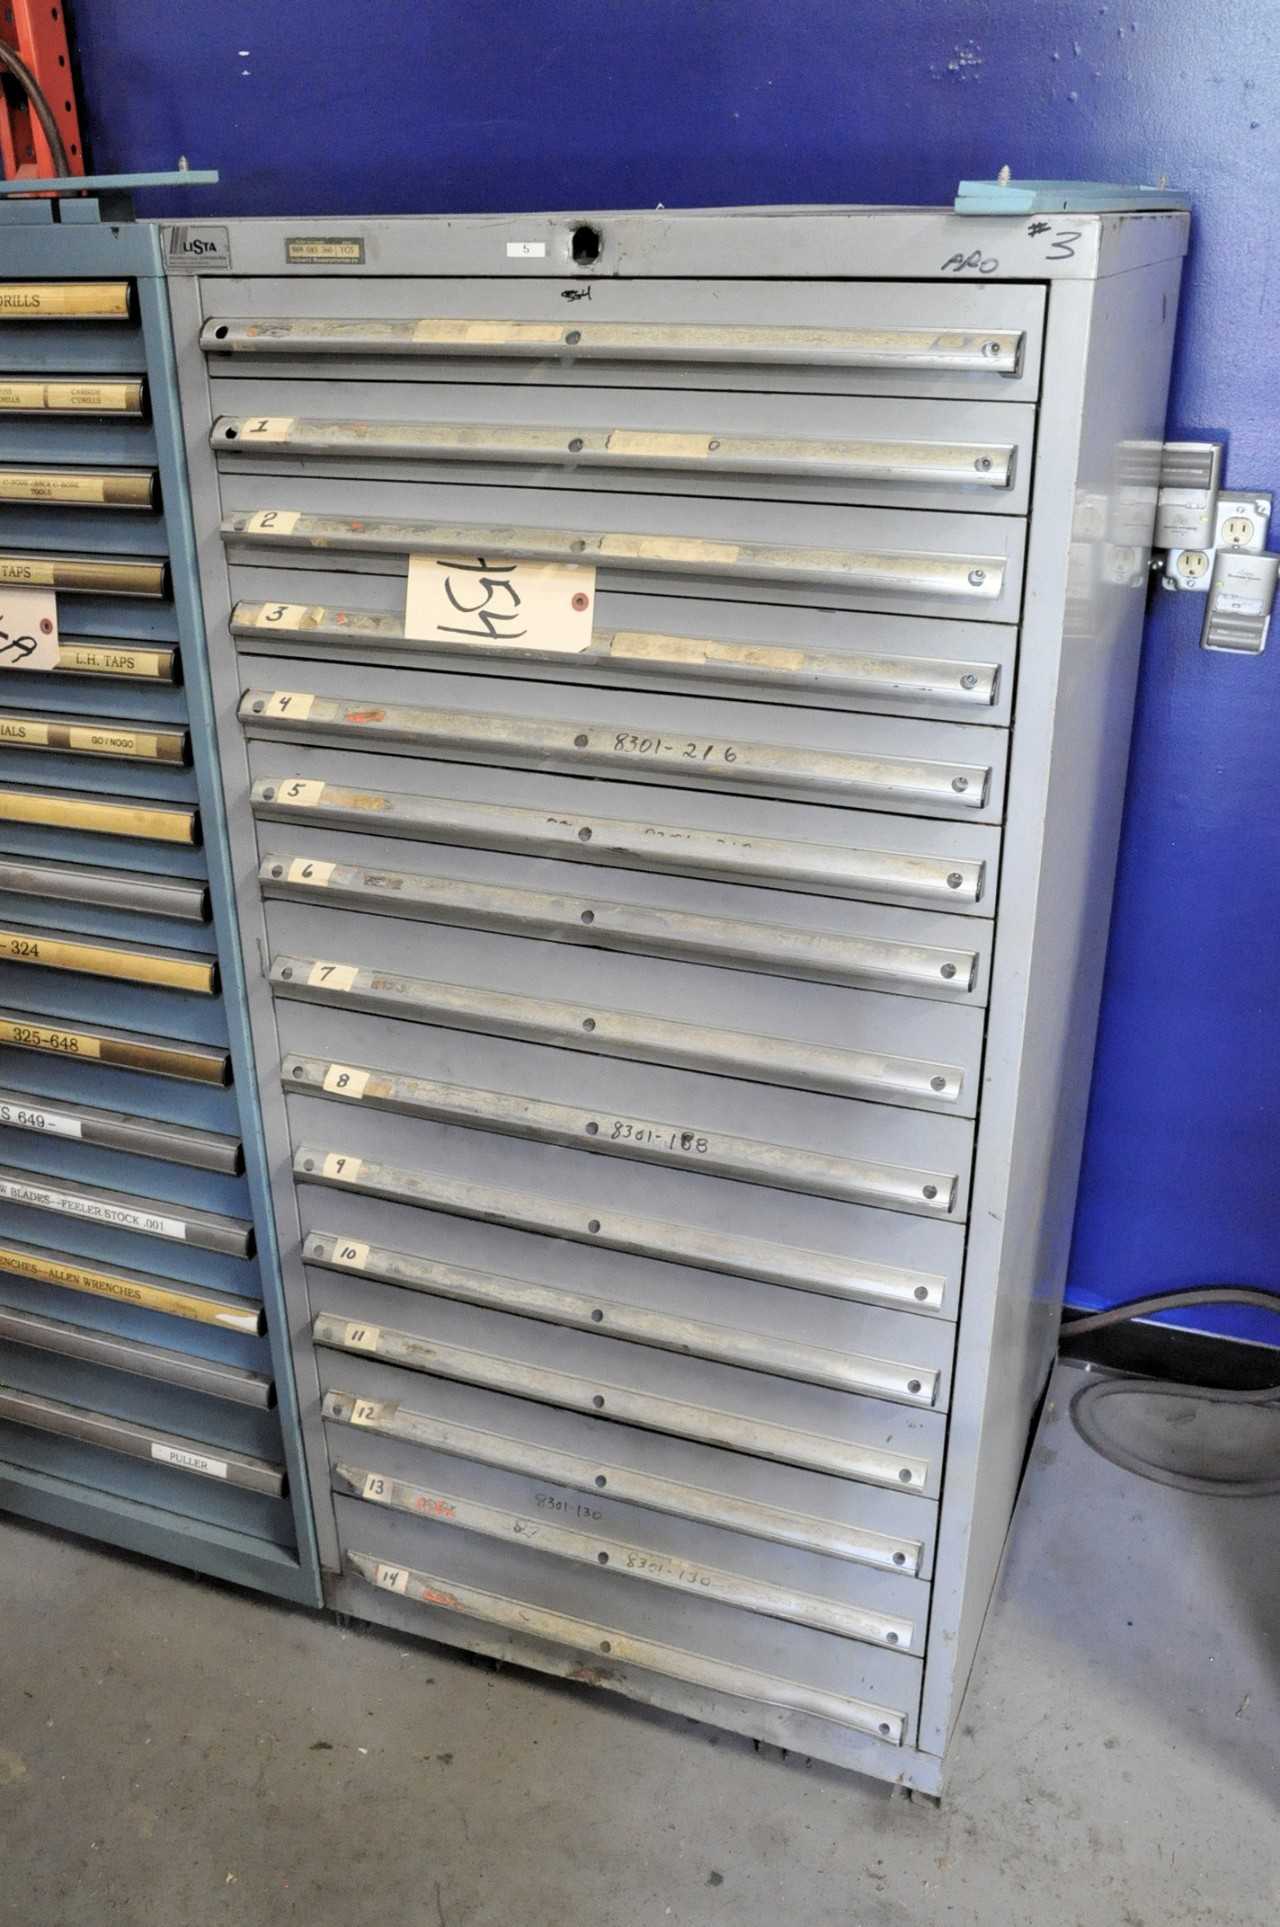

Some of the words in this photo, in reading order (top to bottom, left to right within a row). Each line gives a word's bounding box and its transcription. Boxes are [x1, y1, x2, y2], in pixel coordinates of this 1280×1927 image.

[250, 420, 269, 433] 1
[260, 511, 277, 528] 2
[3, 566, 31, 579] TAPS
[266, 605, 287, 622] 3
[104, 655, 135, 669] TAPS
[279, 696, 292, 712] 4
[288, 783, 306, 797] 5
[301, 864, 313, 878] 6
[320, 966, 337, 981] 7
[13, 1027, 79, 1052] 325-648
[336, 1073, 350, 1088] 8
[336, 1158, 346, 1174] 9
[105, 1210, 140, 1226] STOCK
[340, 1247, 356, 1260] 10
[83, 1276, 142, 1300] WRENCHES
[351, 1330, 365, 1342] 11
[358, 1407, 375, 1421] 12
[169, 1451, 209, 1471] PULLER
[368, 1479, 385, 1495] 13
[383, 1571, 400, 1586] 14
